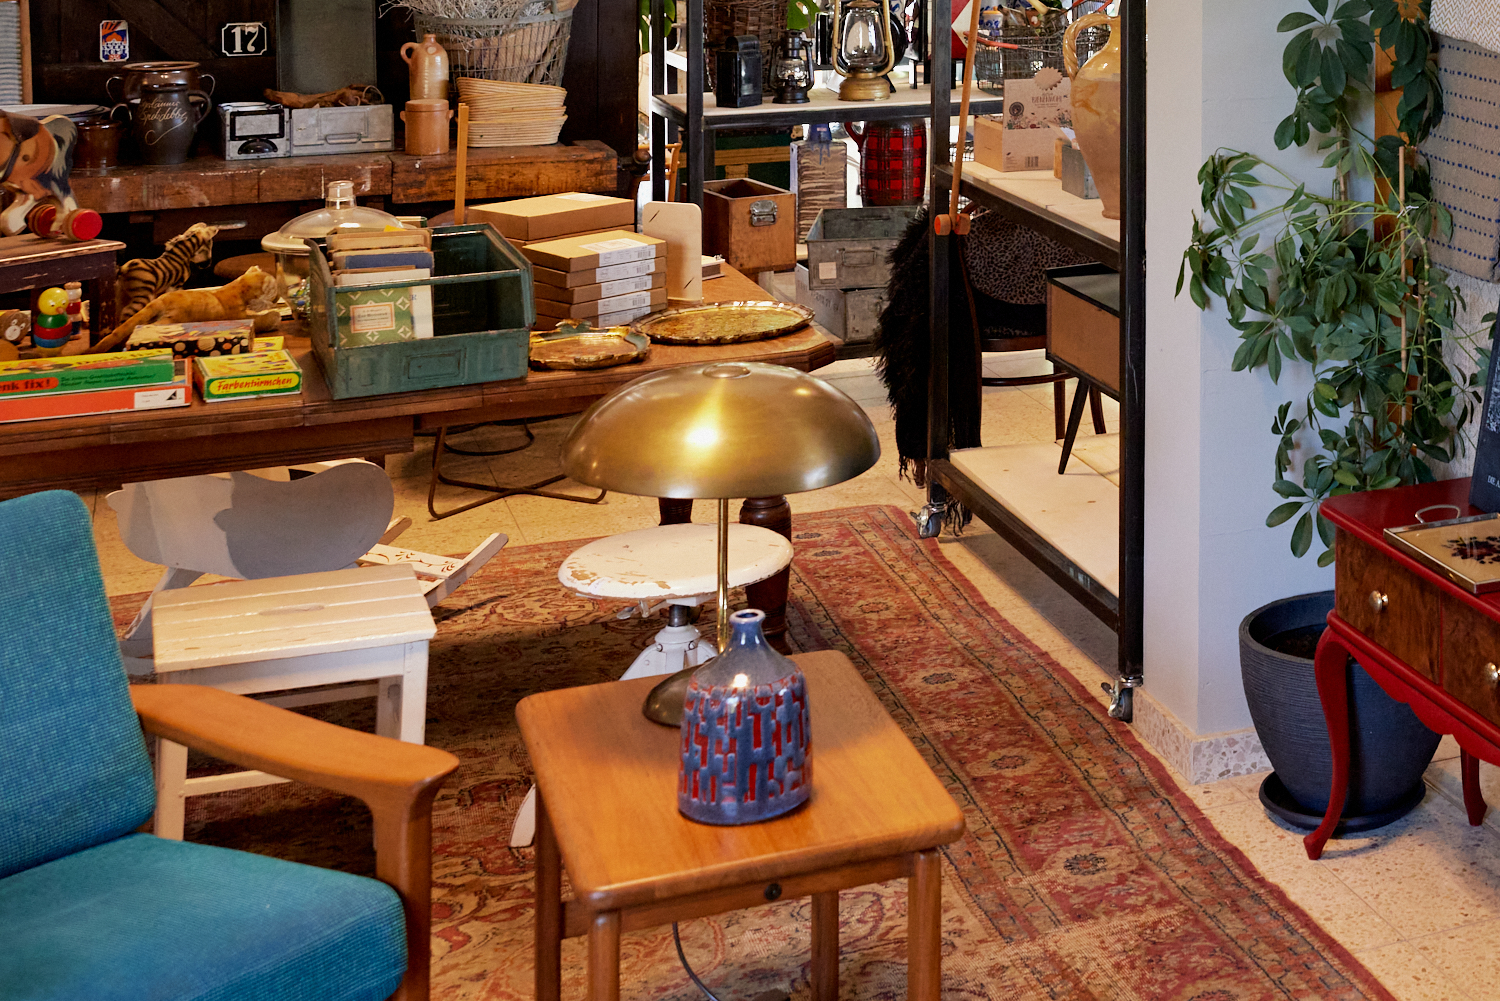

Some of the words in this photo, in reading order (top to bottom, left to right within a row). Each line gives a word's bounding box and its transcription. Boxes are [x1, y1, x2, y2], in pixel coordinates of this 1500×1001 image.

[231, 25, 260, 54] 17
[24, 378, 51, 390] fix!
[216, 375, 294, 392] Farbentürmchen
[1487, 475, 1497, 486] DIE
